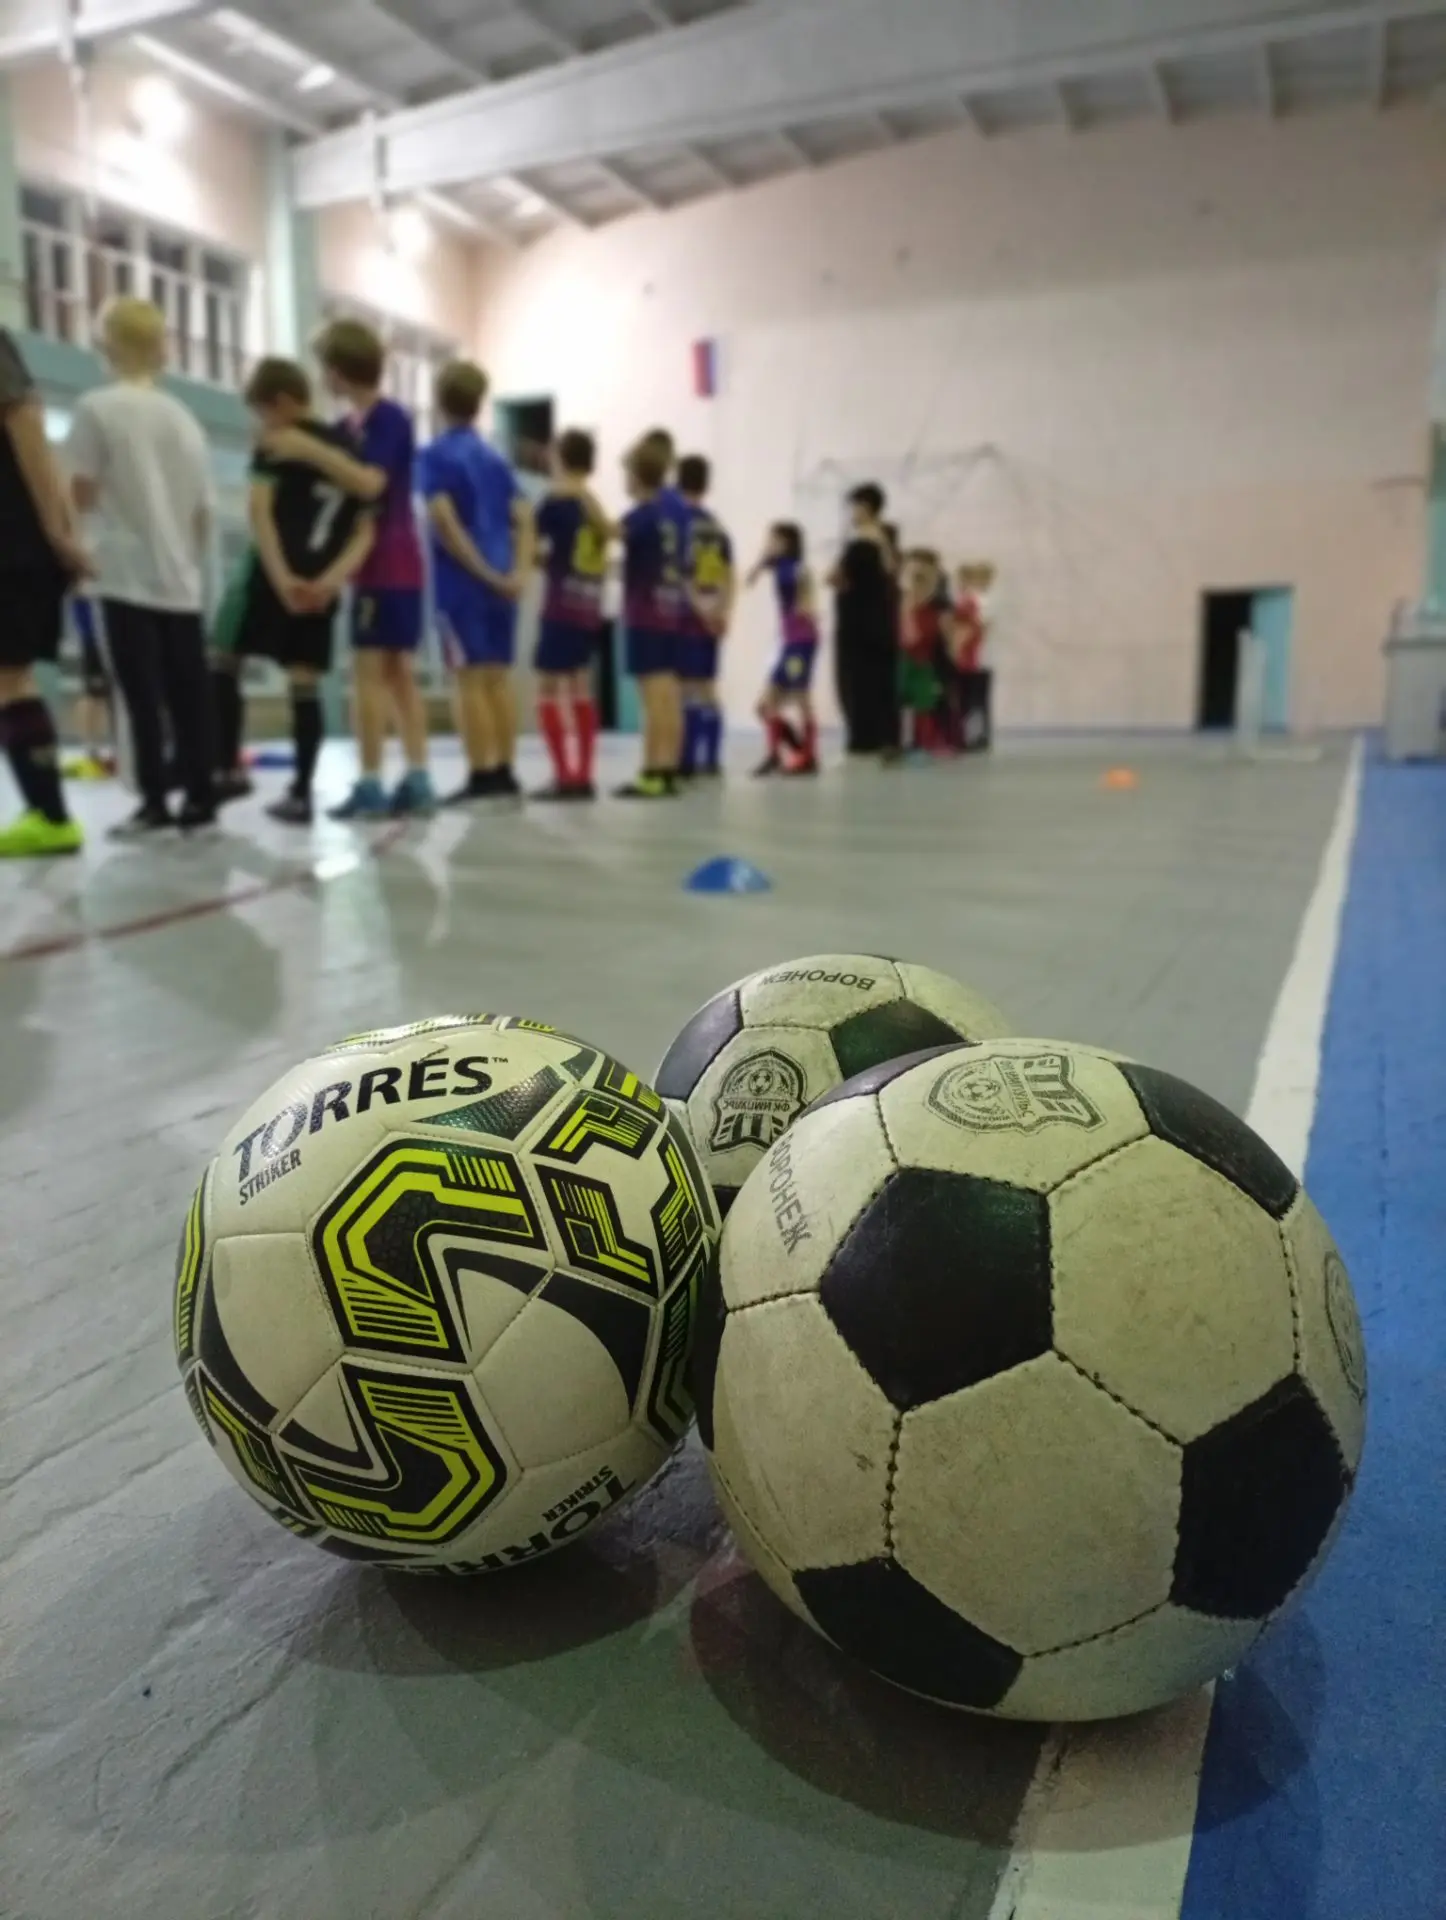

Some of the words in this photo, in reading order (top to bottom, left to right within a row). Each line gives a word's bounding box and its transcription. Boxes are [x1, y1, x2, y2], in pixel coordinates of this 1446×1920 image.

[310, 481, 345, 551] 7
[761, 969, 876, 991] ВОРОНЕЖ
[722, 1099, 772, 1111] ИМПУЛЬС
[239, 1148, 302, 1206] STRIKER
[542, 1465, 614, 1522] STRIKER
